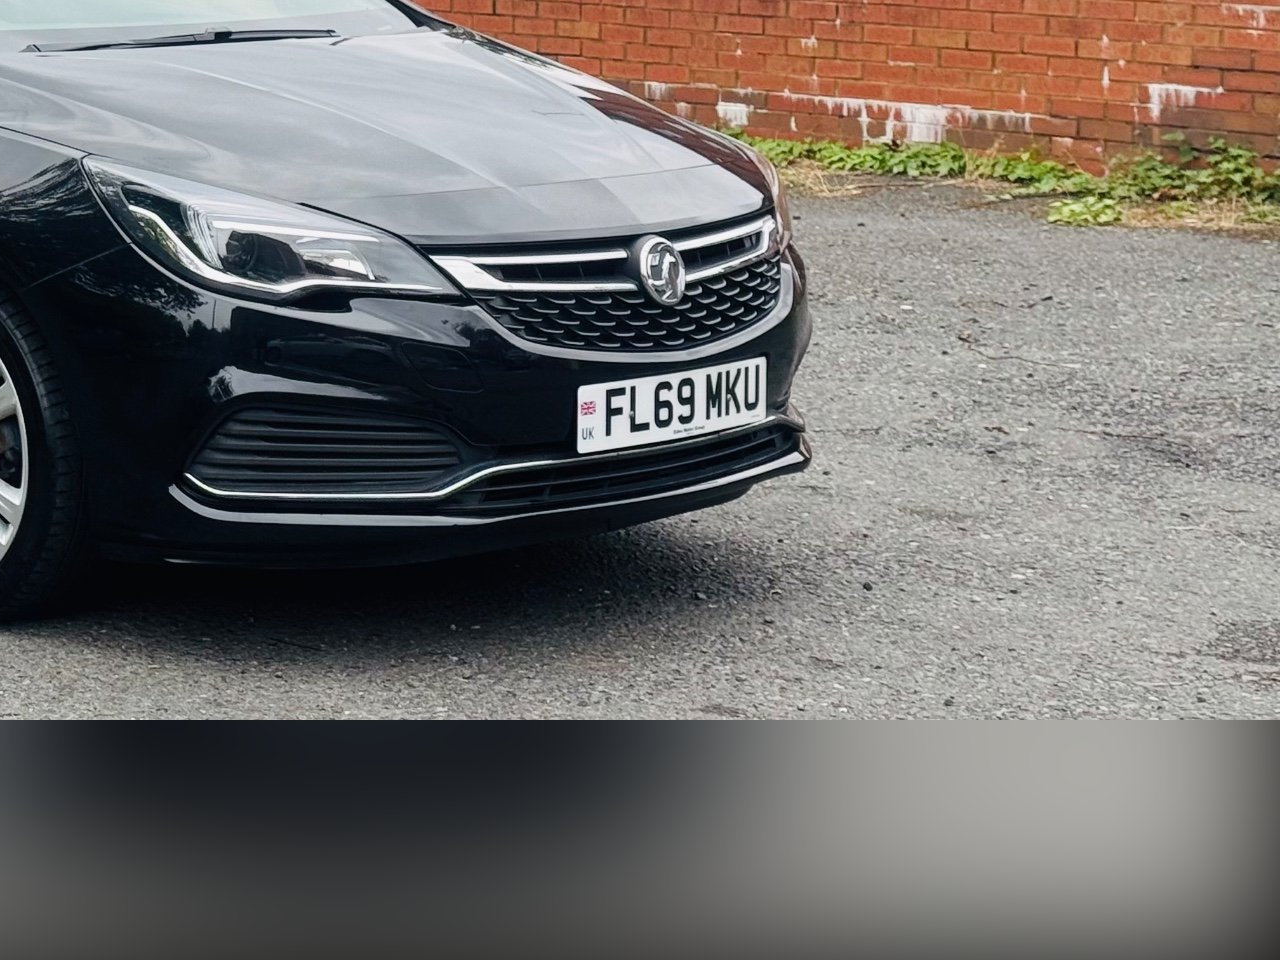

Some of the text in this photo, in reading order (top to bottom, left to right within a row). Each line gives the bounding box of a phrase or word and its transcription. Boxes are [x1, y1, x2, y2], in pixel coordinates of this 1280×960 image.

[605, 364, 761, 437] FL69 MKU
[581, 426, 595, 440] UK
